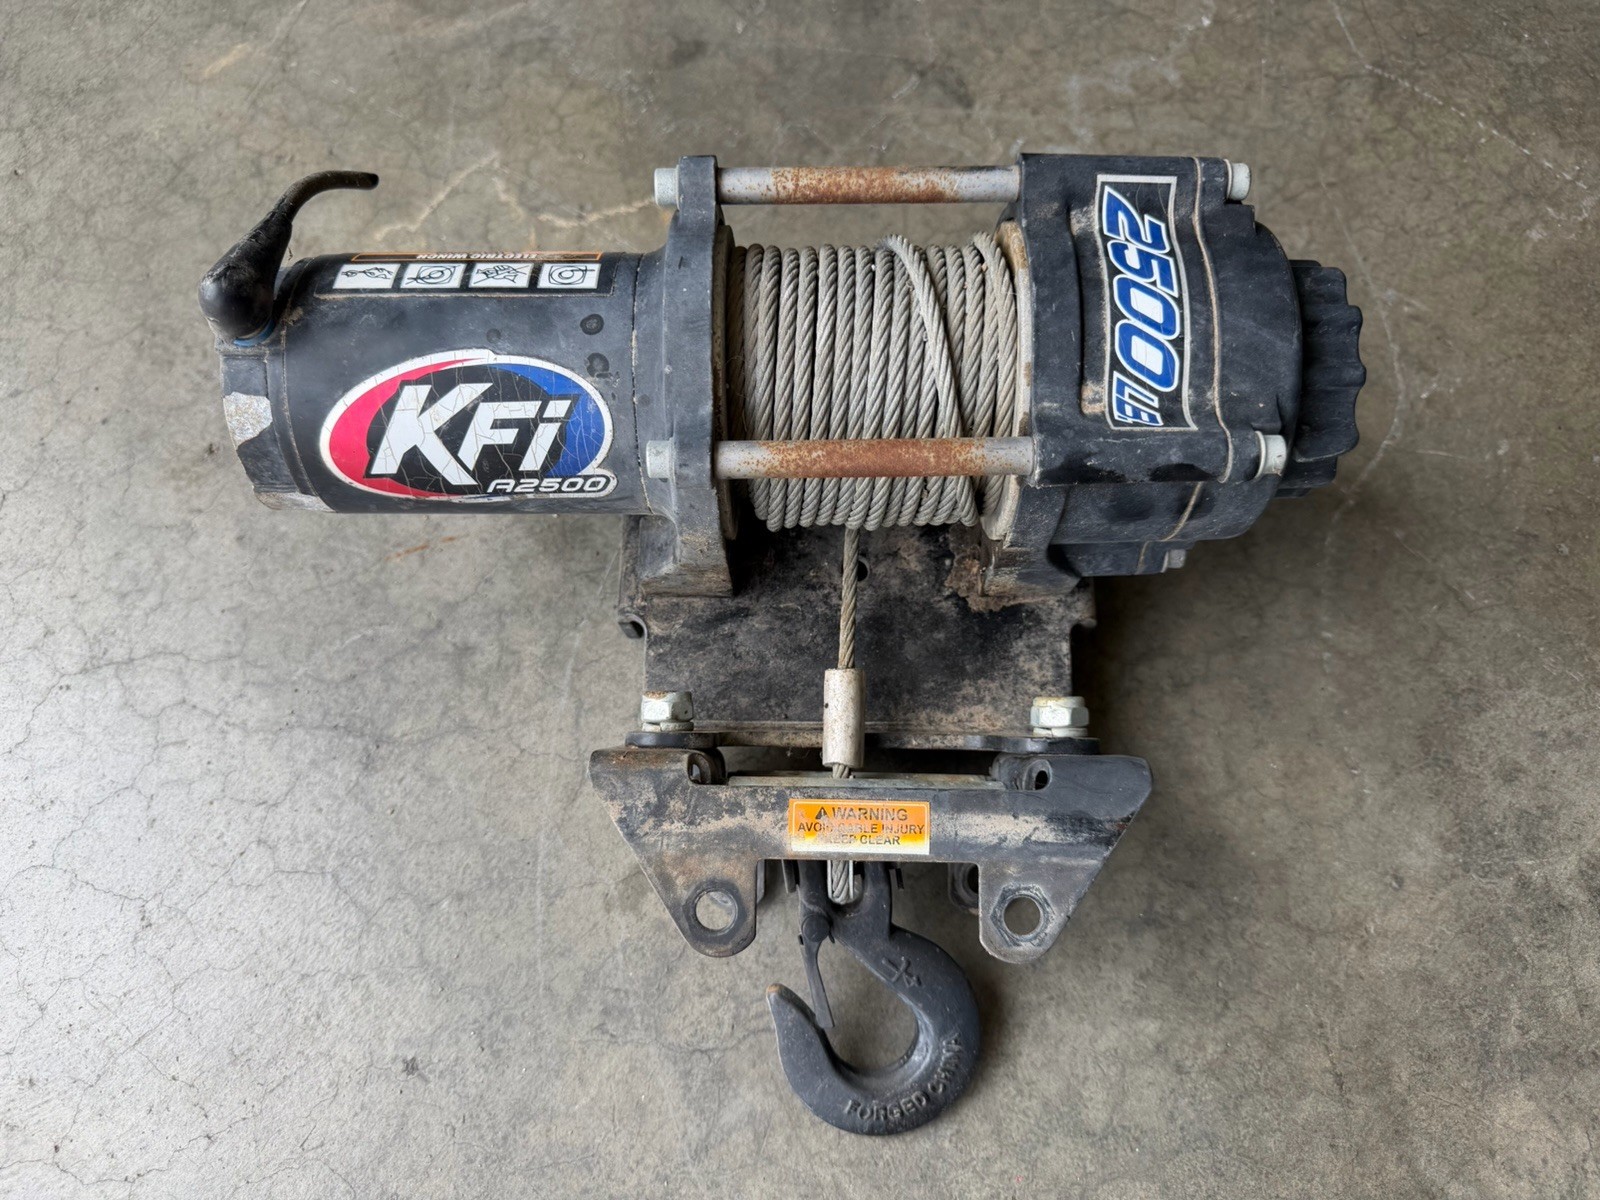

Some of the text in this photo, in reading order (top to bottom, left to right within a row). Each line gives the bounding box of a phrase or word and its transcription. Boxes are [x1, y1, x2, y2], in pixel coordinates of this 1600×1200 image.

[1102, 185, 1180, 392] 2500
[487, 478, 605, 493] A2500
[832, 806, 908, 821] WARNING
[881, 823, 925, 836] INJURY
[859, 834, 901, 846] CLEAR
[843, 1091, 927, 1121] FORGED
